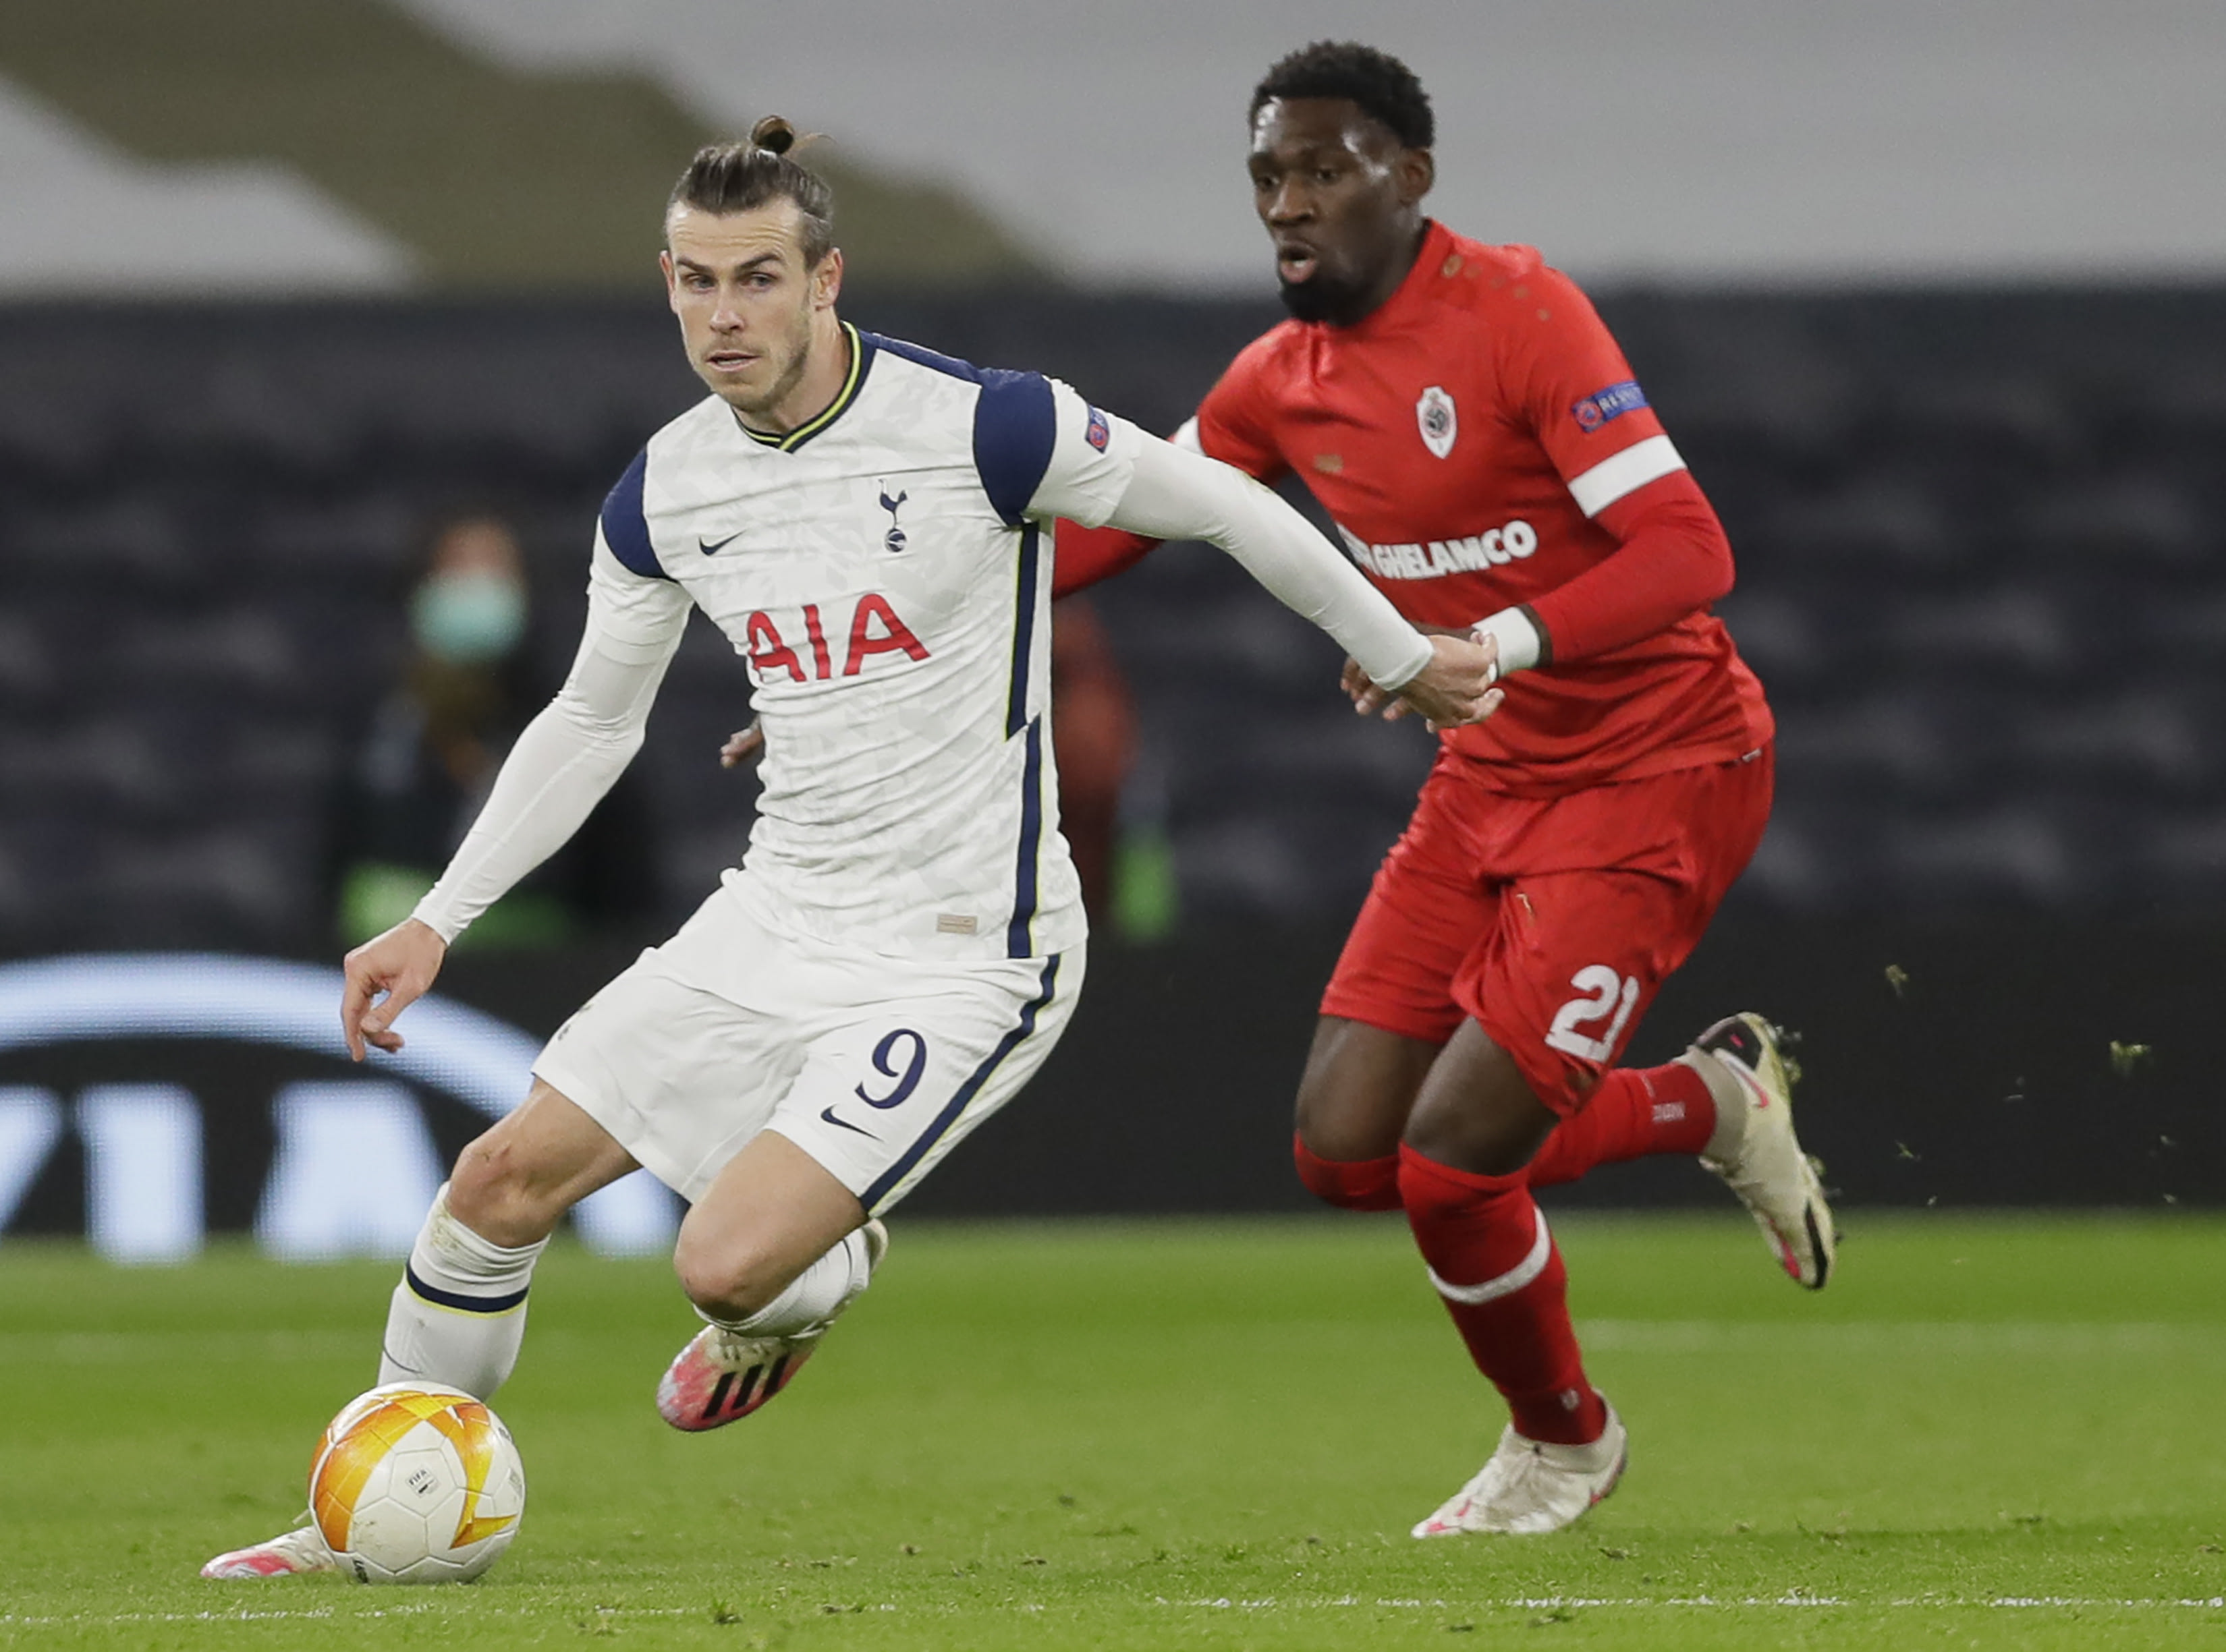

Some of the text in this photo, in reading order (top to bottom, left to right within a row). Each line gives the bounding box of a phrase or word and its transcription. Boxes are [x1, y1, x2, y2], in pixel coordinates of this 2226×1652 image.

[1371, 520, 1538, 579] GHELAMCO
[747, 594, 931, 682] AIA
[1545, 964, 1640, 1063] 21
[855, 1027, 926, 1109] 9
[408, 1469, 427, 1485] FIFA
